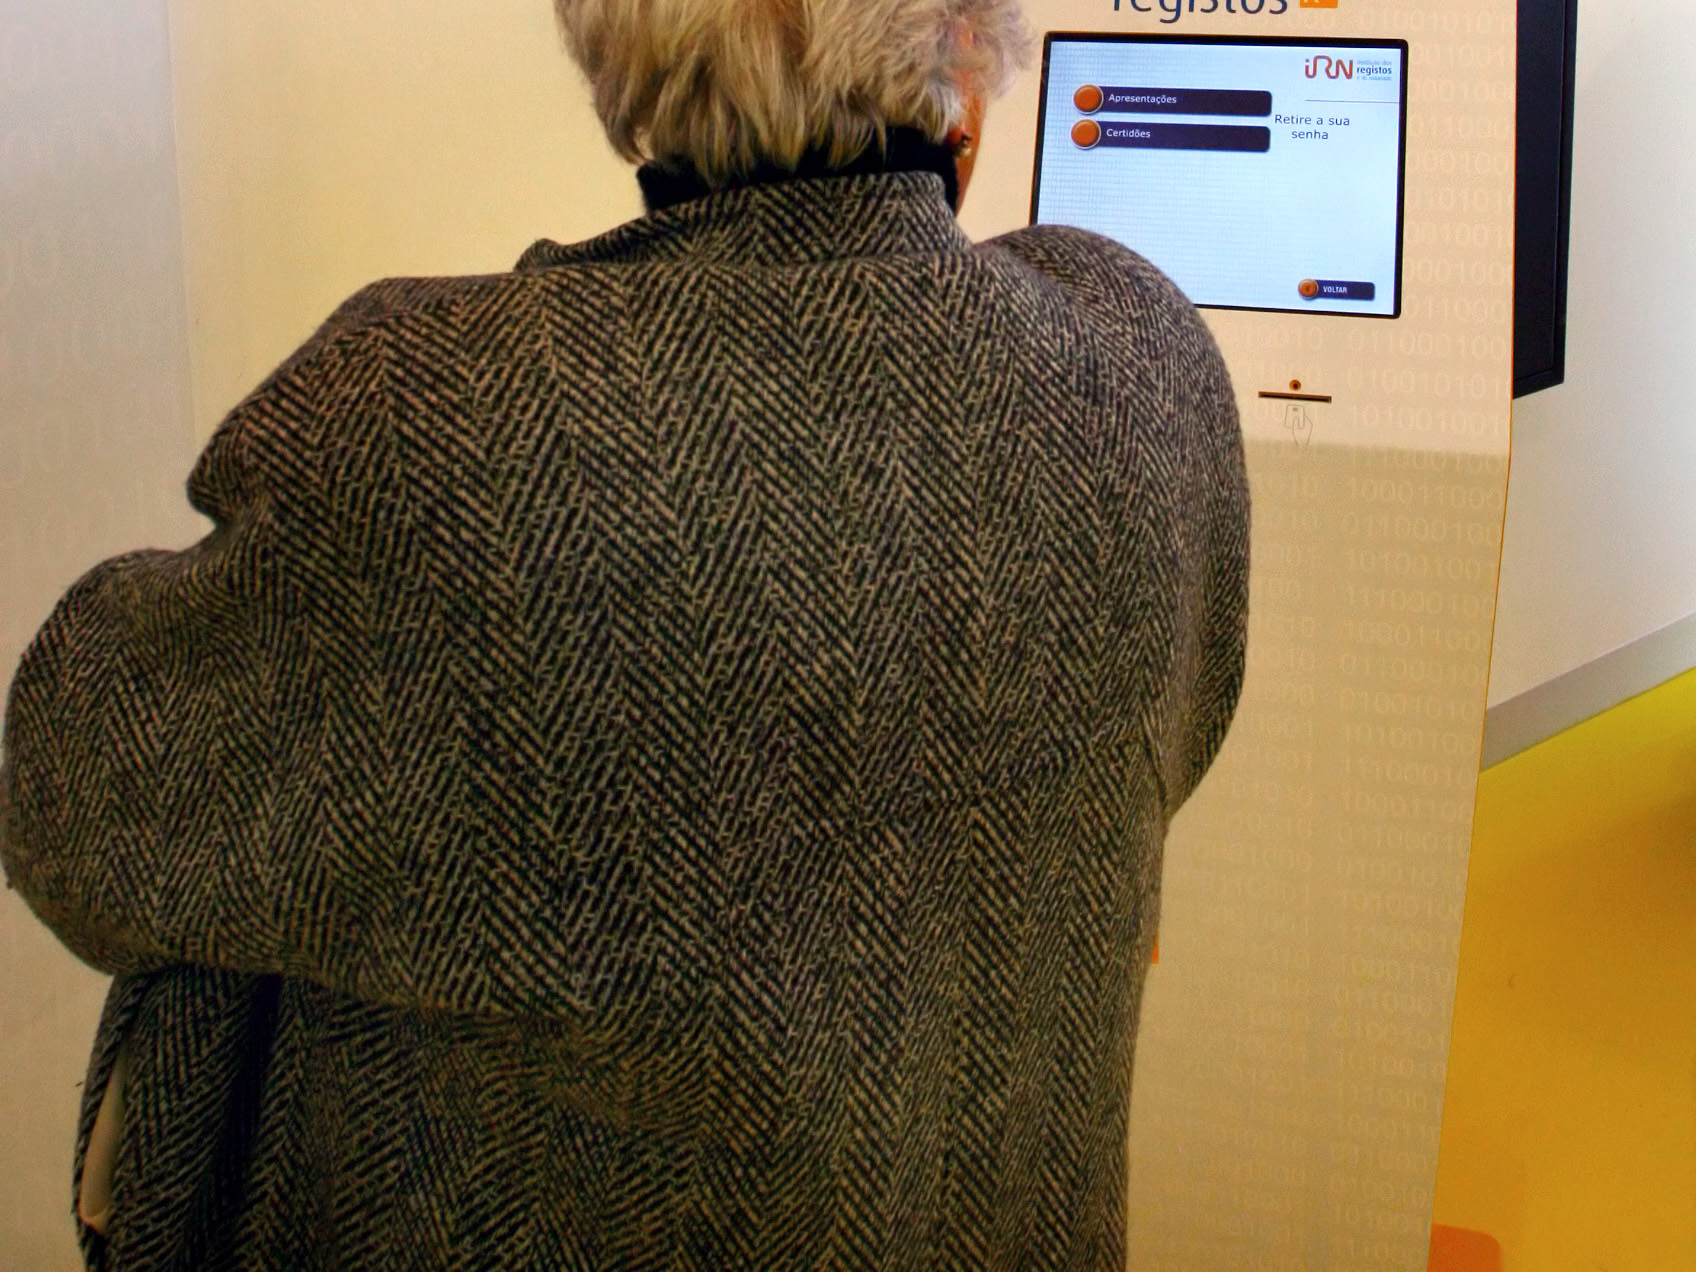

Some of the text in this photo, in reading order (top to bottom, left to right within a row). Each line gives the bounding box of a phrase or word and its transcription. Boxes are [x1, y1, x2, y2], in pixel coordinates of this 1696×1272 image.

[1357, 65, 1392, 76] registos
[1108, 93, 1178, 105] Apresentações
[1274, 114, 1350, 126] Retire a sua
[1106, 128, 1151, 138] Certidões
[1291, 130, 1329, 139] senha
[1323, 286, 1348, 294] VOLTAR
